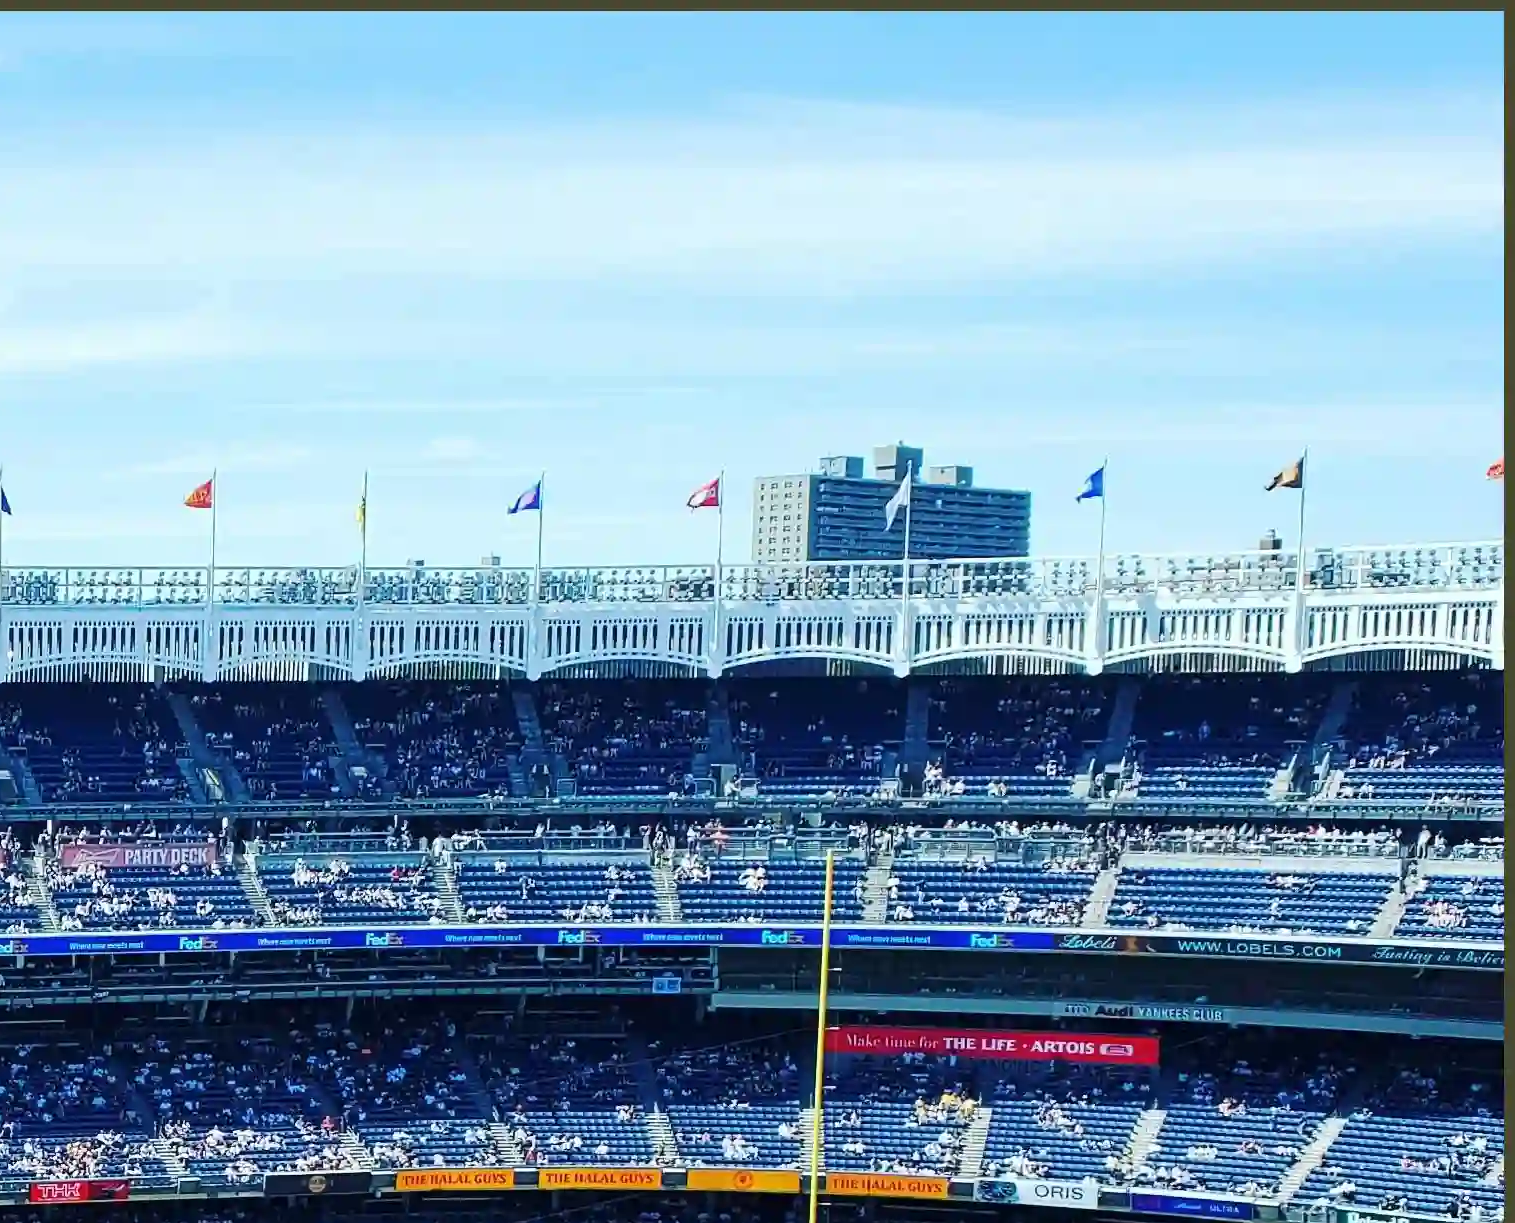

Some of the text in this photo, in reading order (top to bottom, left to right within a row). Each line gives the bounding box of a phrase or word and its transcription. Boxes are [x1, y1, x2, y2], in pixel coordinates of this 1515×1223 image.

[124, 849, 167, 865] PARTY
[170, 848, 208, 865] DECK
[179, 937, 218, 950] FedEx
[366, 932, 404, 945] FedEx
[558, 930, 602, 944] FedEx
[761, 930, 804, 945] FedEx
[970, 933, 1014, 948] FedEx
[1177, 940, 1341, 958] WWW.LOBELS.COM
[1095, 1005, 1223, 1021] Audi YANKEES CLUB
[847, 1033, 881, 1048] Make
[885, 1035, 916, 1049] time
[919, 1035, 939, 1049] for
[943, 1037, 976, 1050] THE
[981, 1038, 1017, 1051] LIFE
[1031, 1040, 1094, 1055] ARTOIS
[402, 1172, 507, 1185] THE HALAL GUYS
[546, 1173, 654, 1184] THE HALAL GUYS
[833, 1178, 942, 1193] THE HALAL GUYS
[37, 1183, 81, 1198] THK
[1034, 1184, 1084, 1200] ORIS
